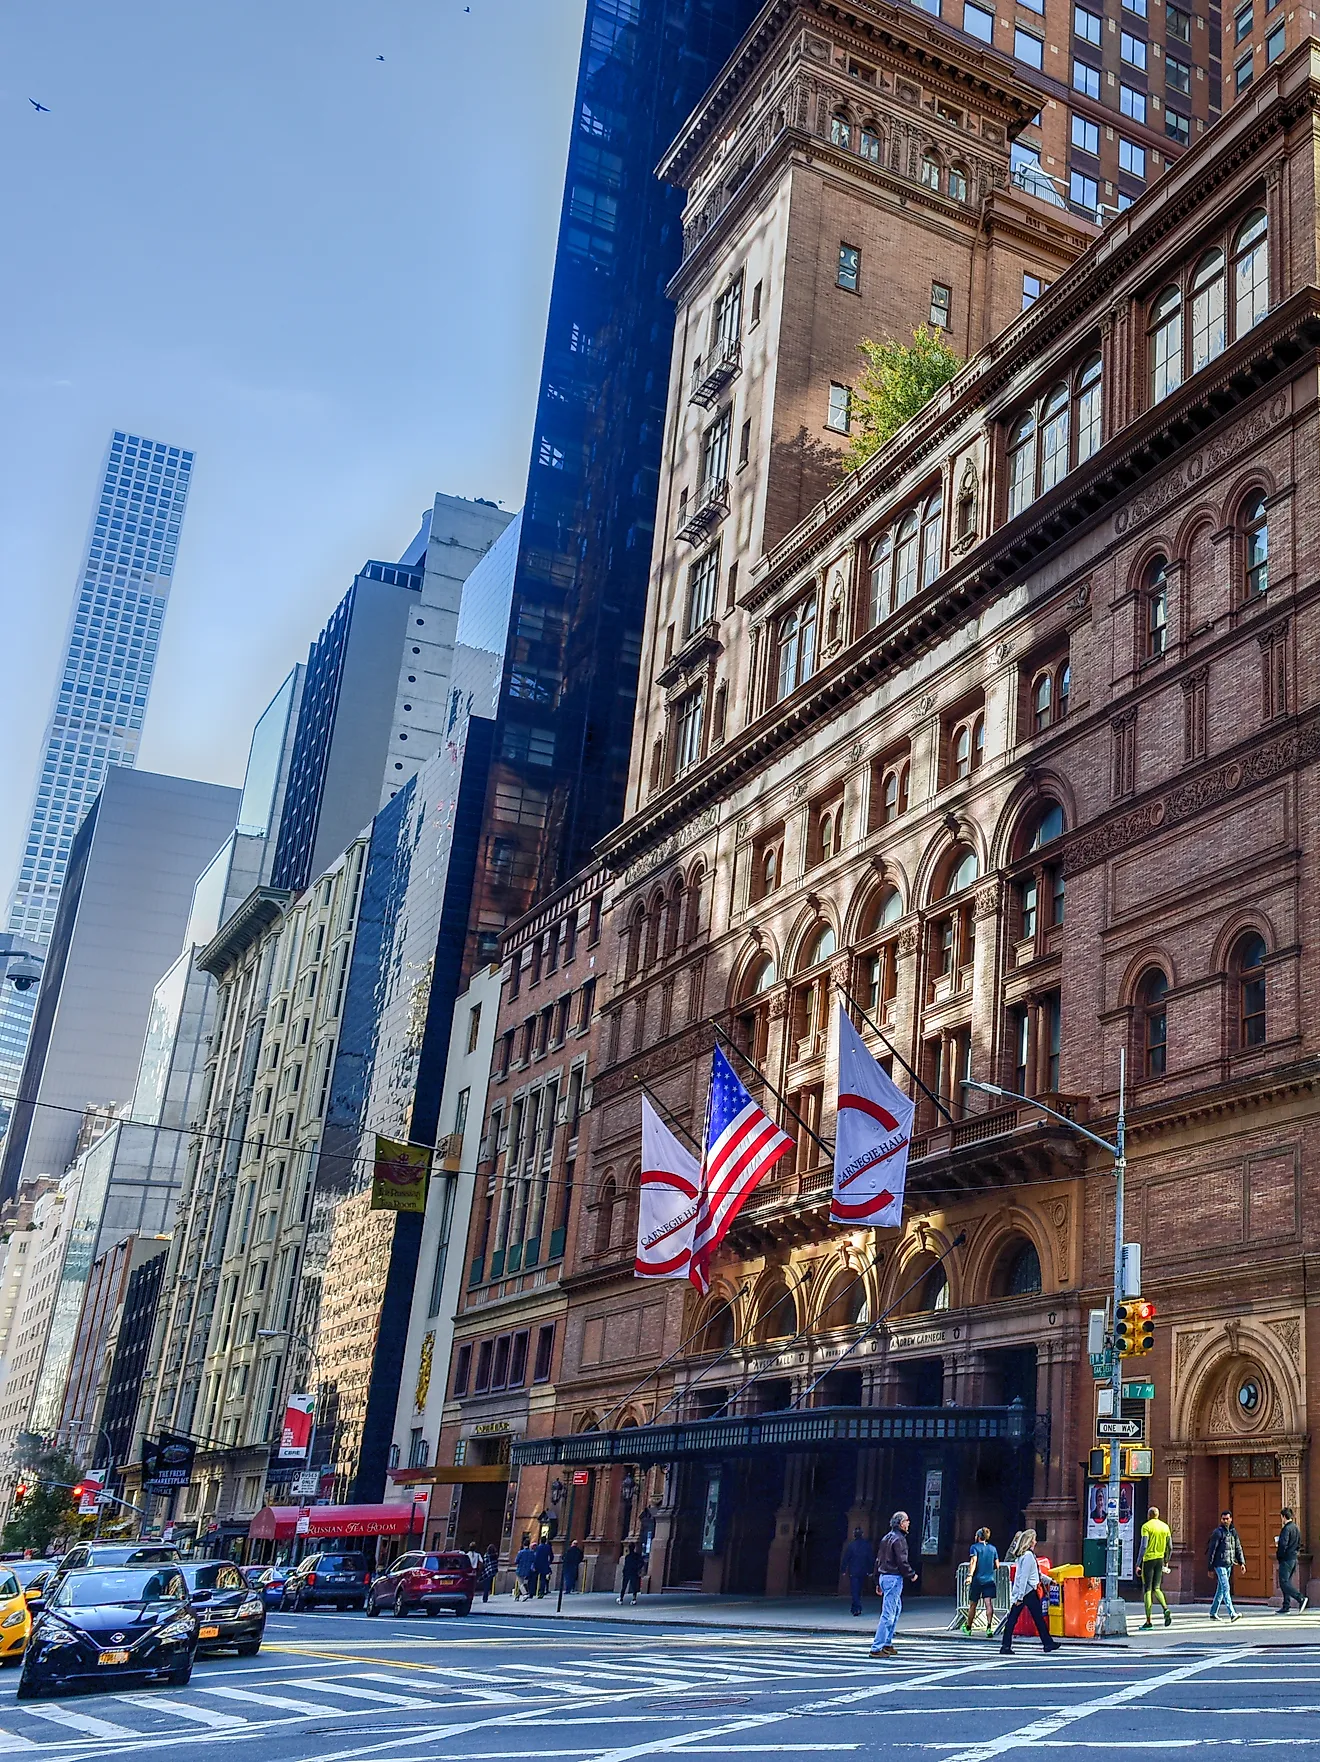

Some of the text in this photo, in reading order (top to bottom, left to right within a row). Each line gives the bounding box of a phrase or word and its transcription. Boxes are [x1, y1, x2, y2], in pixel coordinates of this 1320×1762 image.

[879, 1132, 907, 1154] HALL
[640, 1204, 698, 1246] CARNEGIE HA
[916, 1331, 946, 1344] CARNEGIE
[1135, 1385, 1142, 1397] 7
[1102, 1424, 1136, 1433] ONE WAY
